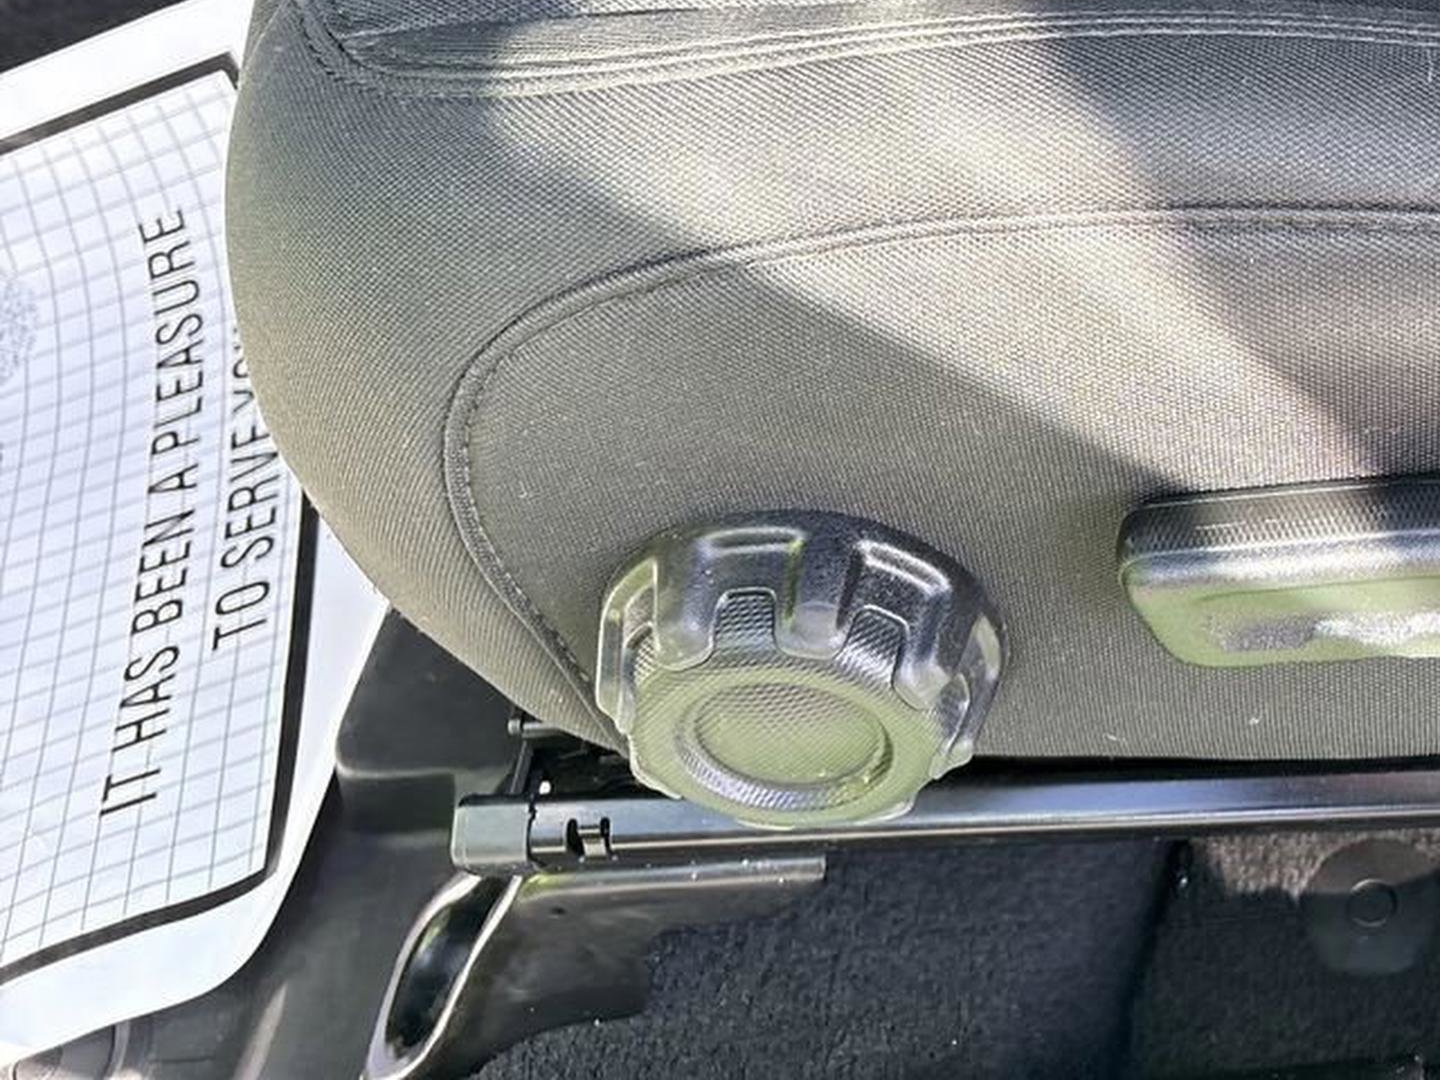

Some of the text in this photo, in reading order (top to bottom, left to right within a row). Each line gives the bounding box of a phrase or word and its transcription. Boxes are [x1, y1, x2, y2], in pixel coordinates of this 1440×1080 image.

[98, 209, 204, 817] IT HAS BEEN A PLEASURE
[211, 424, 281, 651] TO SERVE
